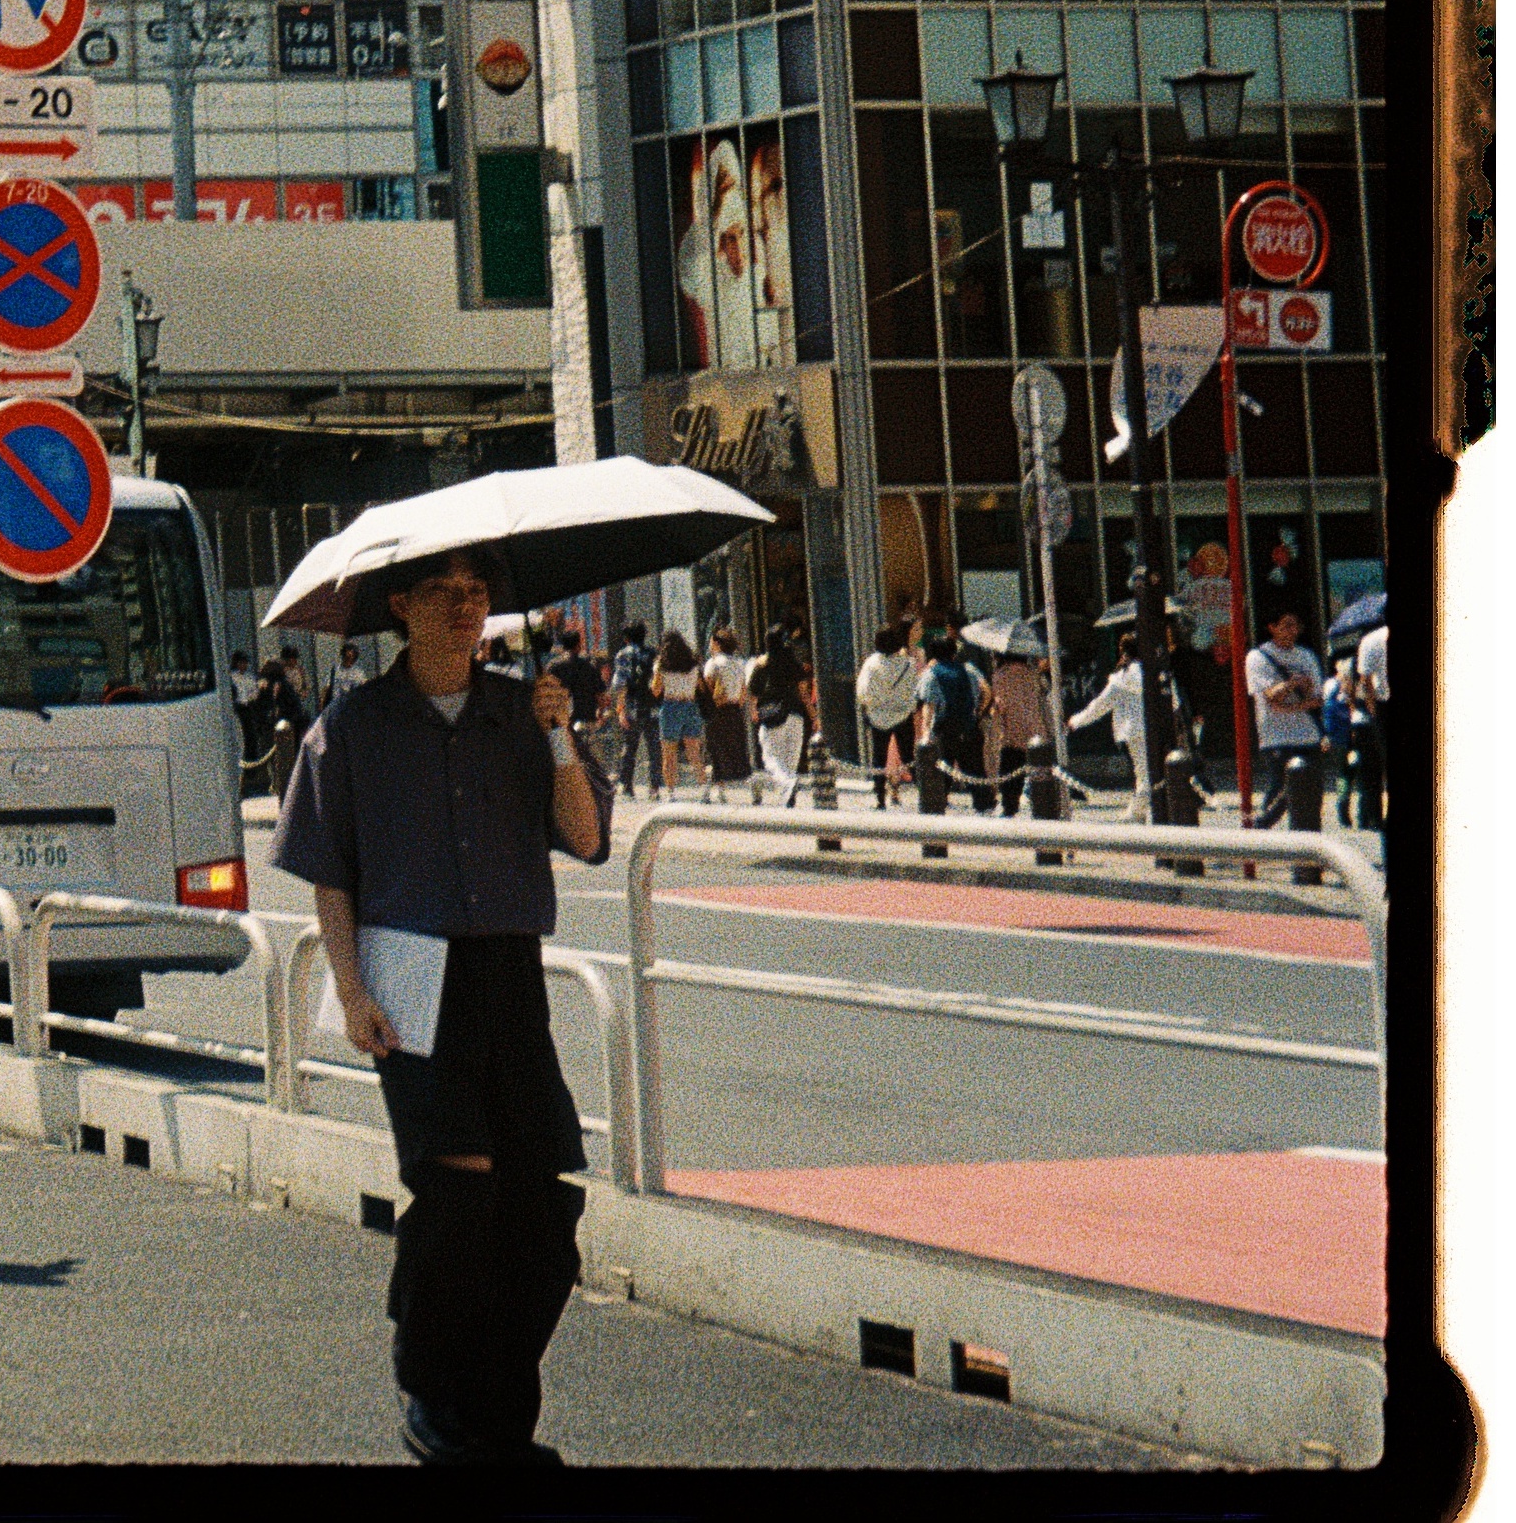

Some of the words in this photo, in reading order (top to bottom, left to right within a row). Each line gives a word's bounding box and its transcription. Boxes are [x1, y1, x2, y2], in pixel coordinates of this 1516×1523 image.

[7, 181, 49, 204] 7-20
[1251, 223, 1307, 256] 消火栓
